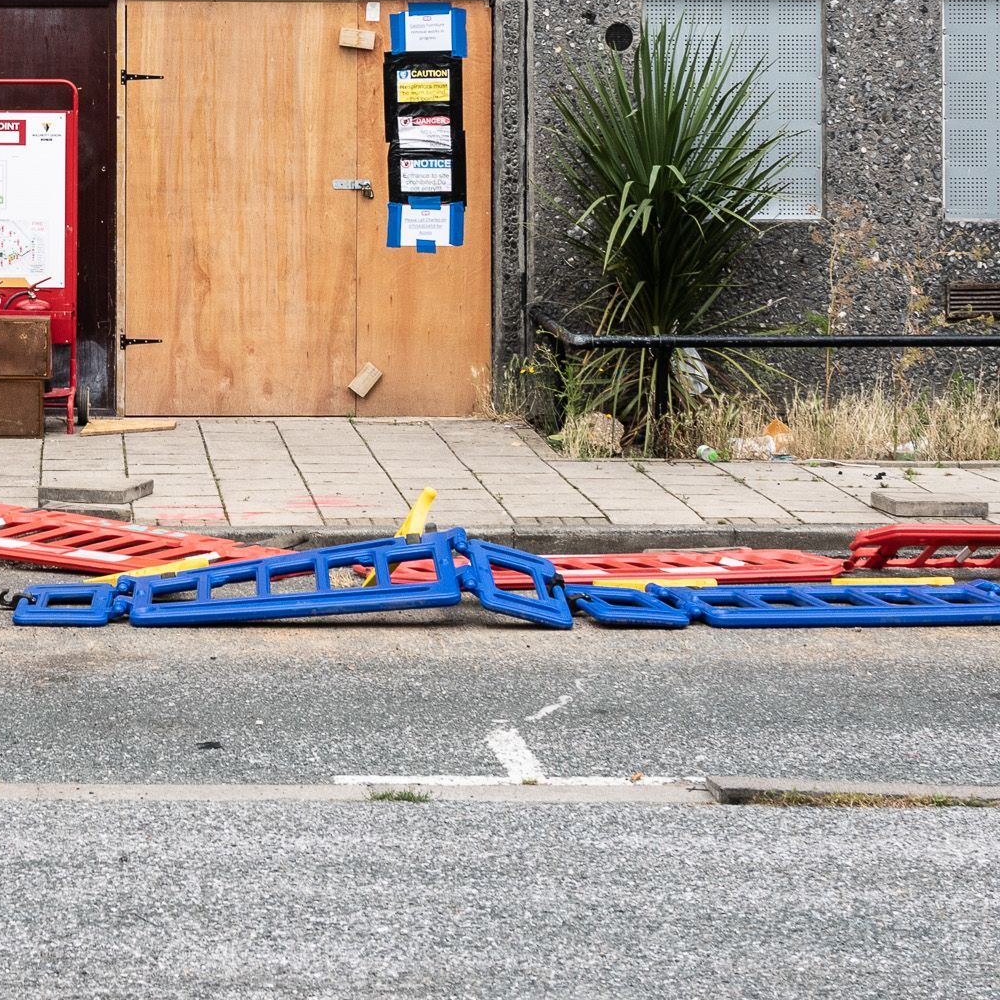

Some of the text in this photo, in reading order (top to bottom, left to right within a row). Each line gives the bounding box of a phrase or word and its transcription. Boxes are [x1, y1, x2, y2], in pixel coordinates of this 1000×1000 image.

[411, 70, 448, 78] CAUTION
[416, 117, 446, 125] DANGER
[414, 160, 451, 168] NOTICE
